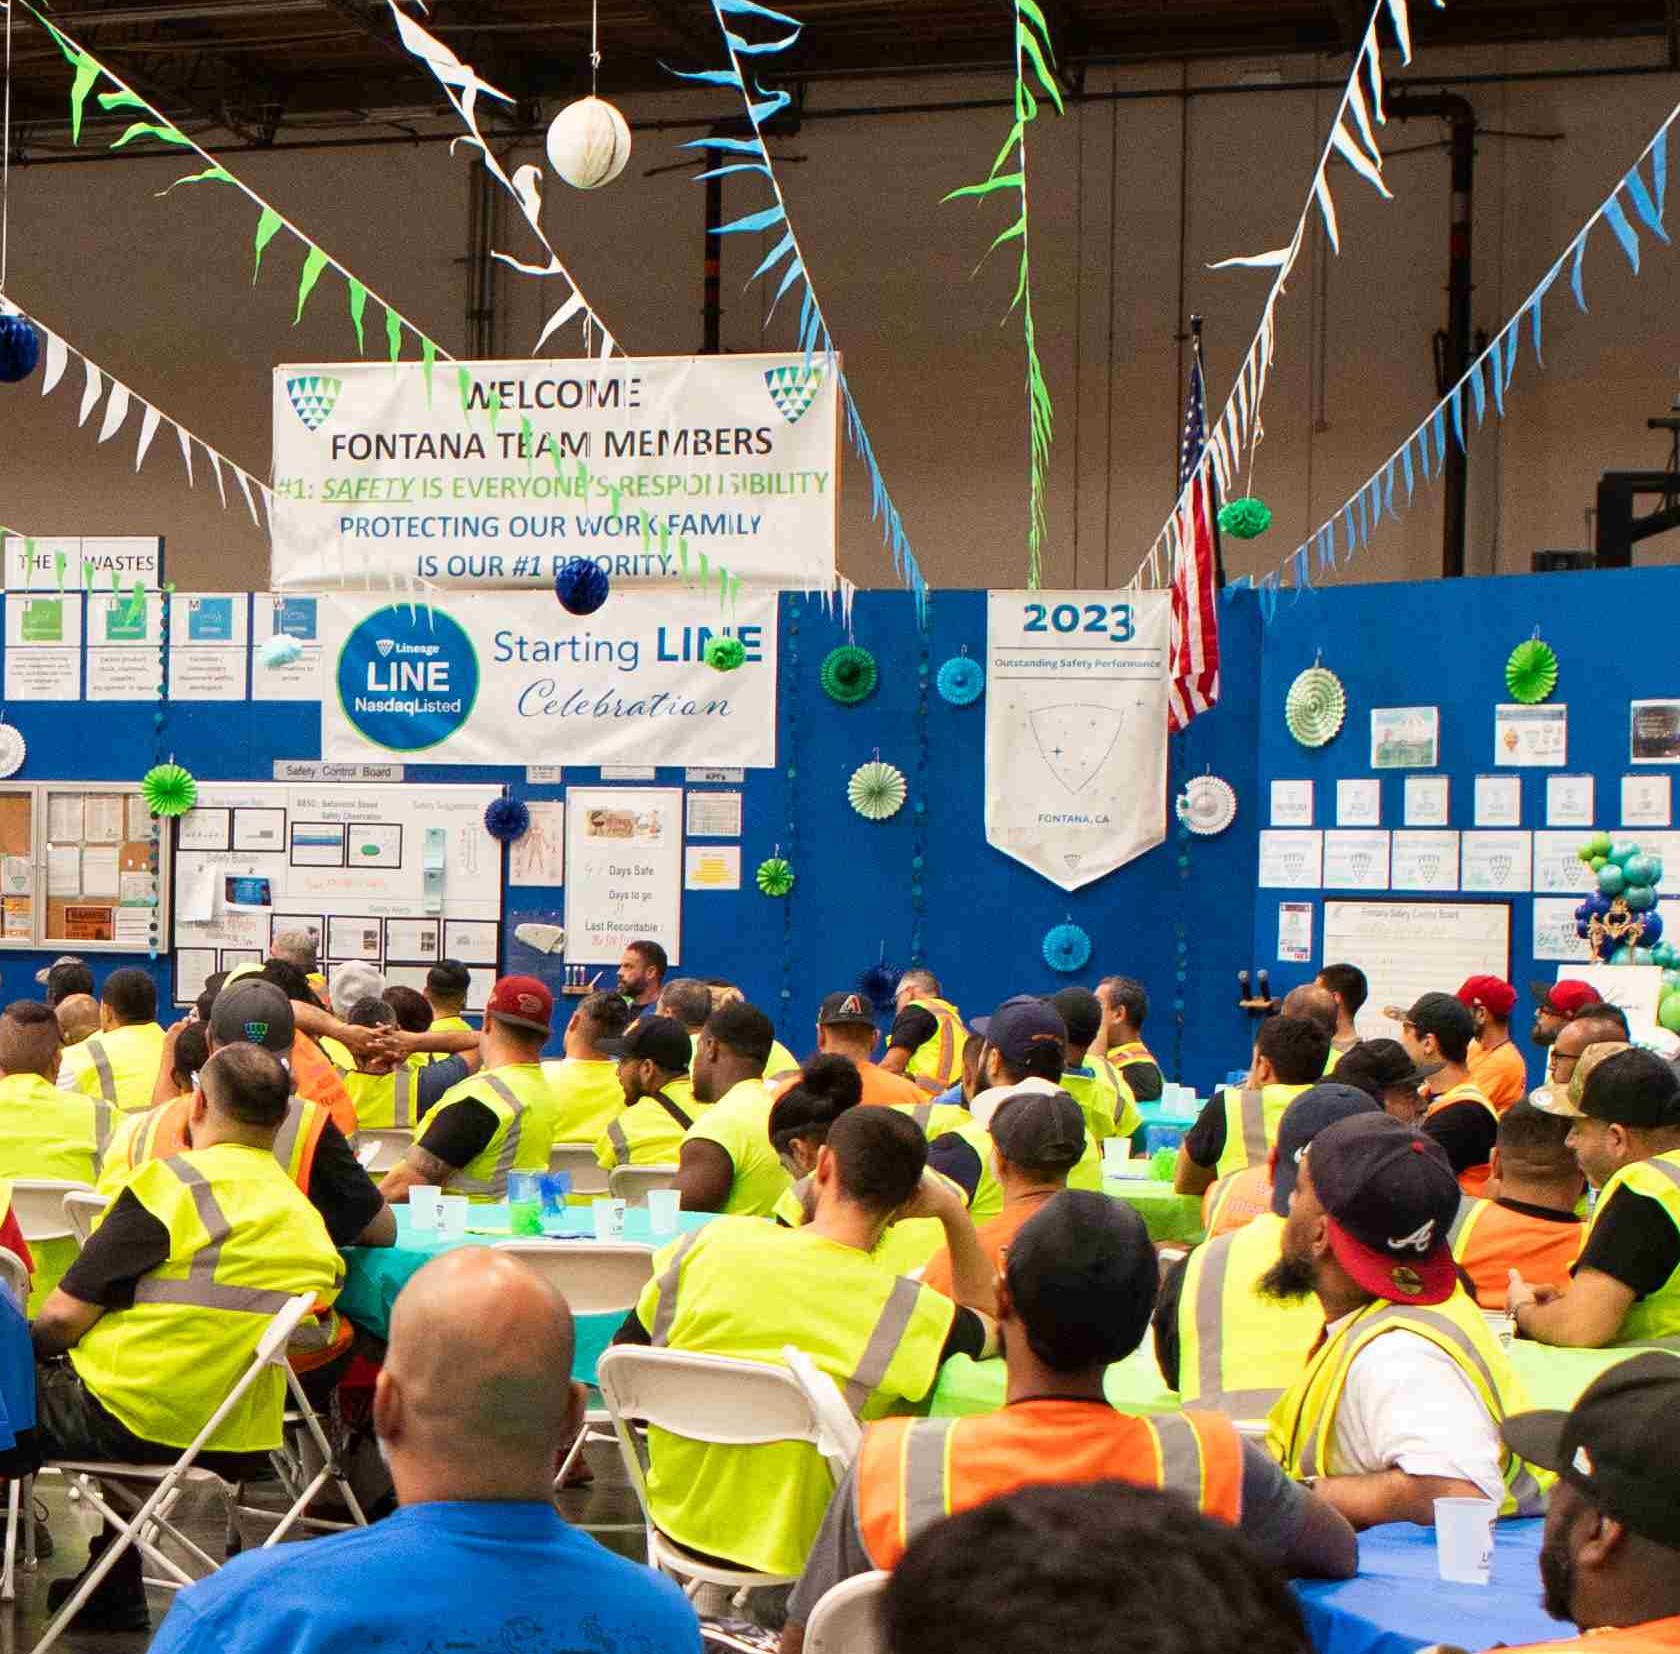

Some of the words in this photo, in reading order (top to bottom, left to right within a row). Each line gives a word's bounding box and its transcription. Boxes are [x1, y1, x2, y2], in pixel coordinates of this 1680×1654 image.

[467, 378, 641, 410] WELCOME
[332, 431, 486, 460] FONTANA
[497, 429, 590, 459] TEAM
[604, 426, 773, 458] MEMBERS
[321, 476, 413, 502] SAFETY
[422, 477, 441, 498] IS
[340, 515, 502, 539] PROTECTING
[508, 515, 566, 539] OUR
[576, 514, 658, 538] WORK
[667, 513, 762, 537] FAMILY
[417, 555, 438, 577] IS
[447, 554, 504, 577] OUR
[512, 555, 542, 577] #1
[1024, 604, 1136, 643] 2023
[395, 643, 440, 656] Lineage
[494, 630, 639, 671] Starting
[994, 658, 1057, 669] Outstanding
[1060, 658, 1092, 669] Safety
[1095, 658, 1161, 668] Performance
[367, 661, 450, 692] LINE
[355, 697, 461, 716] NasdaqListed
[516, 678, 731, 718] Celebration
[286, 765, 315, 778] Safety
[322, 765, 356, 776] Control
[363, 767, 391, 777] Board
[1038, 814, 1092, 825] FONTANA,
[1095, 814, 1110, 824] CA
[609, 866, 632, 879] Days
[634, 866, 654, 876] Safe
[609, 890, 632, 903] Days
[585, 922, 605, 932] Last
[606, 921, 659, 932] Recordable
